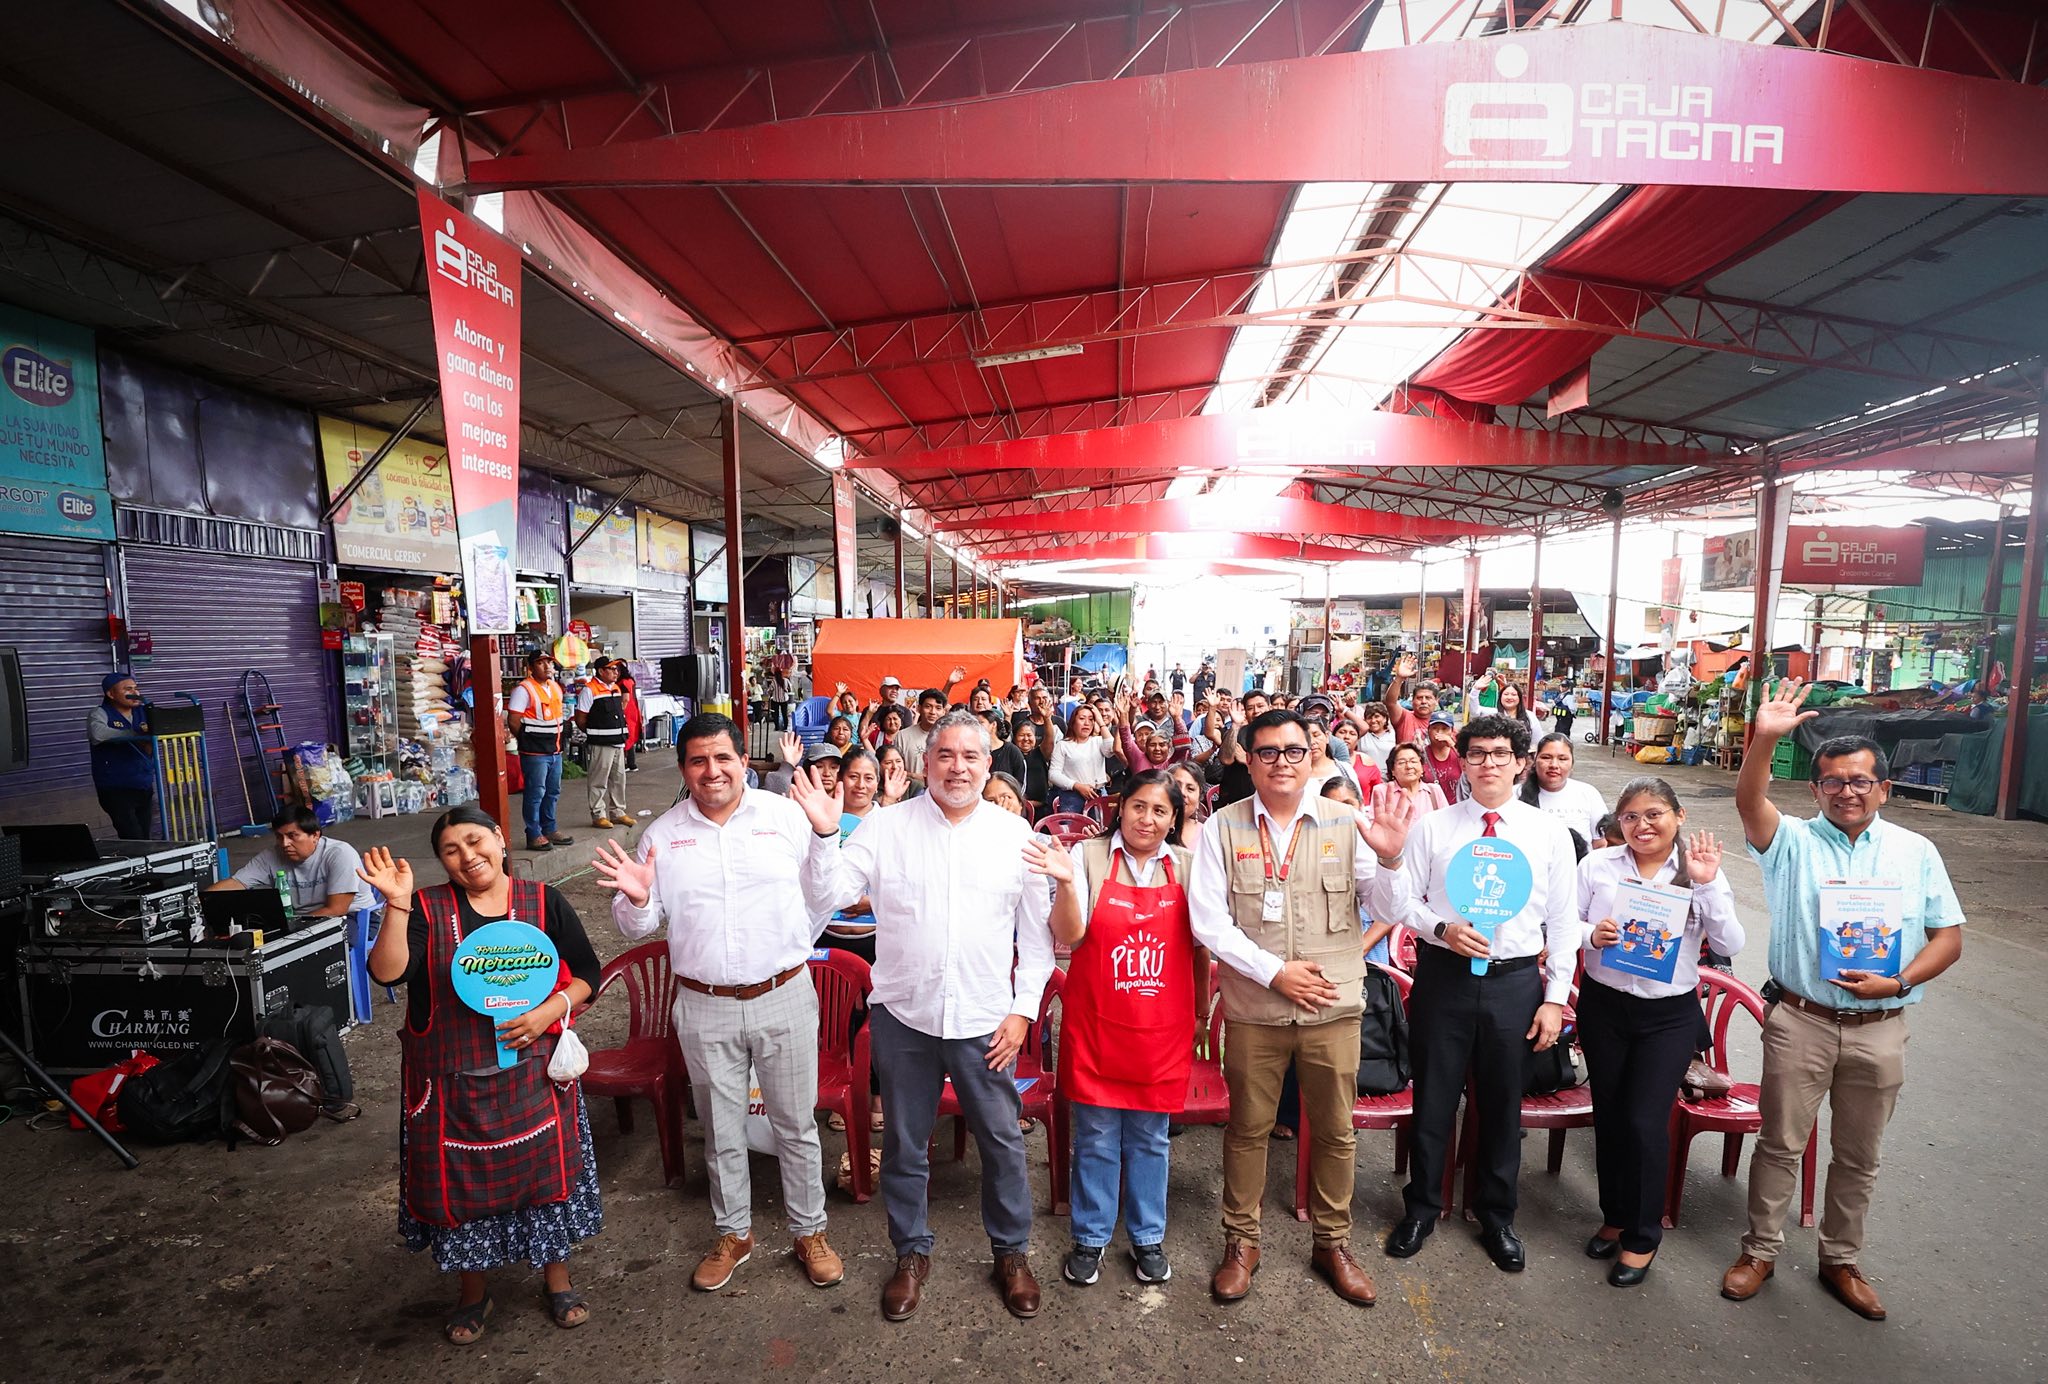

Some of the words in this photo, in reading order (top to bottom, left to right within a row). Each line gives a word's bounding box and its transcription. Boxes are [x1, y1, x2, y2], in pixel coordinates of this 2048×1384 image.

[1581, 83, 1712, 118] CAJA
[1580, 119, 1784, 165] TACNA
[467, 248, 498, 279] CAJA
[468, 265, 514, 308] TACNA
[454, 318, 493, 354] Ahorra
[498, 341, 505, 362] y
[14, 357, 68, 396] Elite
[447, 352, 476, 378] gana
[479, 361, 514, 392] dinero
[463, 390, 485, 412] con
[487, 393, 503, 417] los
[6, 415, 20, 429] LA
[23, 417, 80, 440] SUAVIDAD
[462, 421, 508, 449] mejores
[0, 429, 24, 446] QUE
[29, 434, 43, 449] TU
[47, 438, 90, 457] MUNDO
[19, 449, 76, 469] NECESITA
[462, 448, 512, 480] intereses
[386, 473, 410, 486] cocinan
[412, 475, 417, 486] la
[419, 474, 442, 492] felicidad
[63, 497, 93, 516] Elite
[1841, 542, 1878, 552] CAJA
[1841, 552, 1896, 565] TACNA
[1483, 851, 1512, 860] Empresa
[1475, 899, 1499, 907] MAIA
[475, 945, 524, 955] Fortalece
[524, 943, 536, 953] tu
[1111, 942, 1165, 978] PERÚ
[459, 951, 553, 975] Mercado
[1115, 978, 1166, 994] Imparable
[497, 1000, 529, 1008] Empresa
[88, 1041, 200, 1050] WWW.CHARMINGLED.NE
